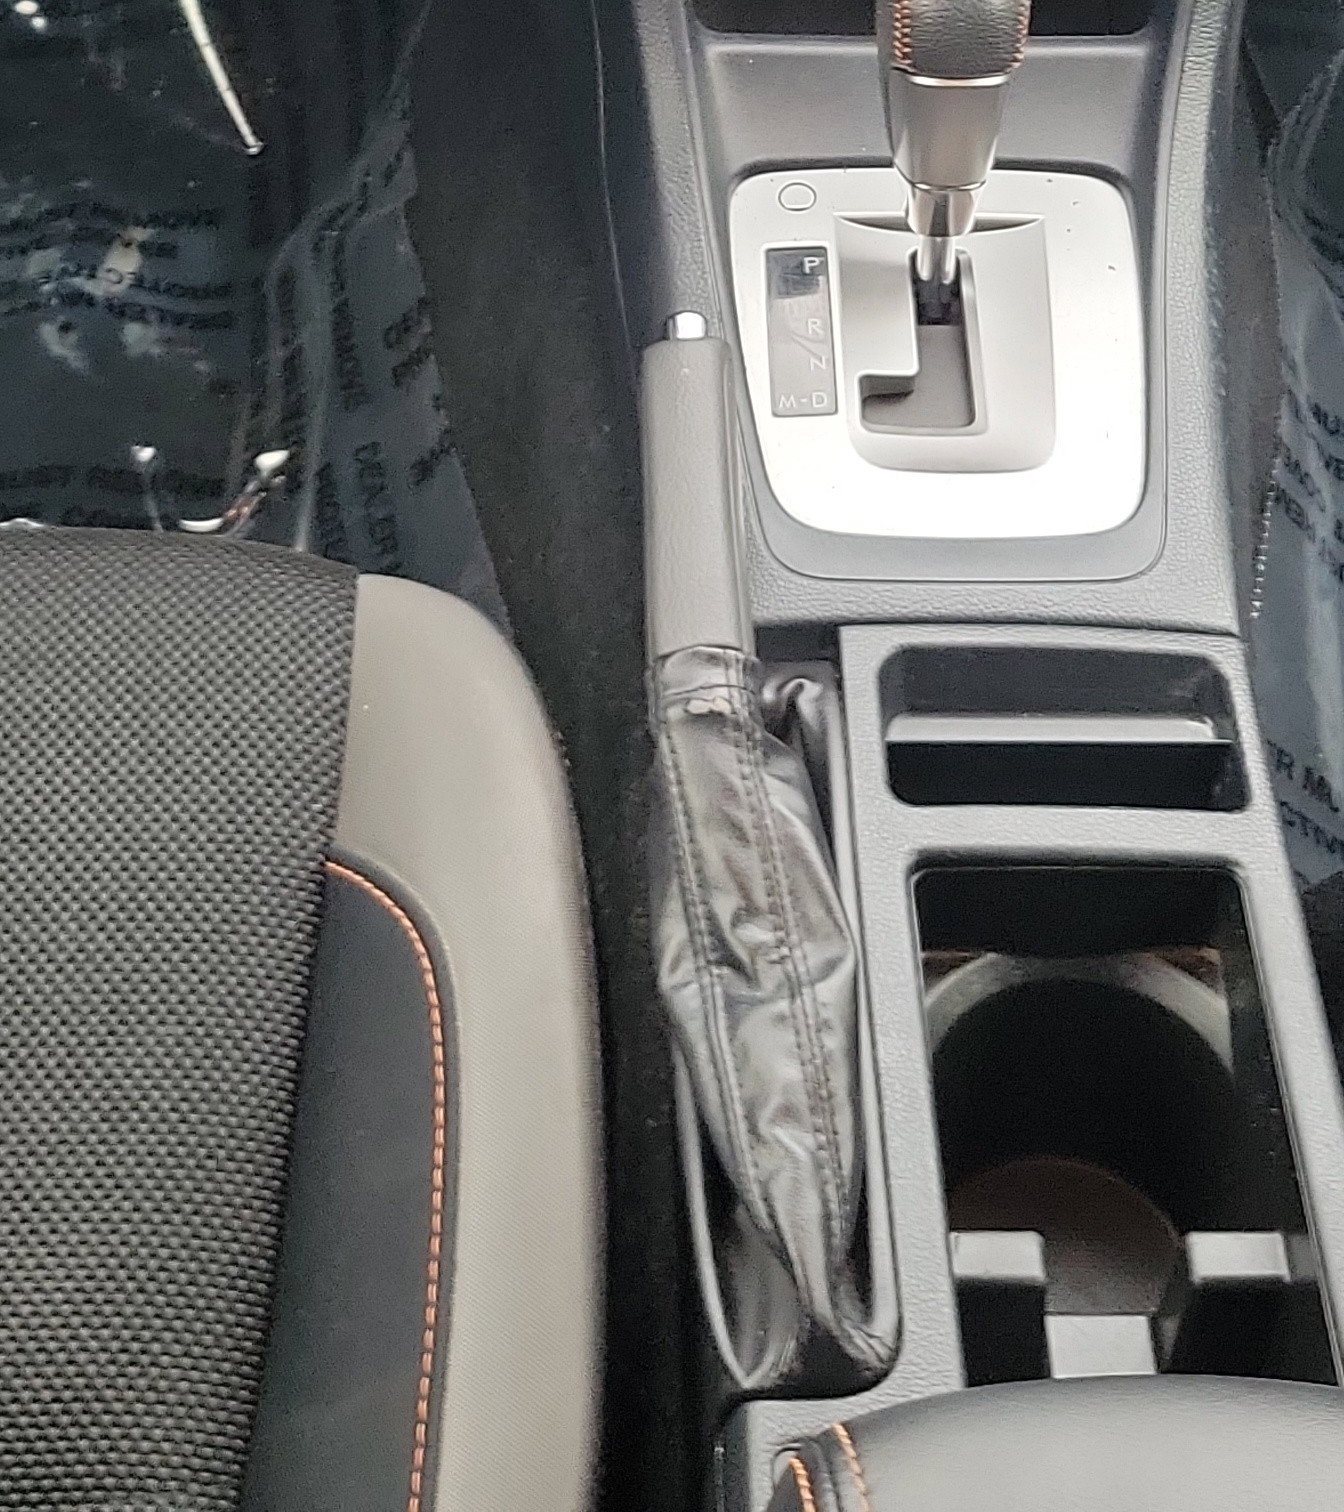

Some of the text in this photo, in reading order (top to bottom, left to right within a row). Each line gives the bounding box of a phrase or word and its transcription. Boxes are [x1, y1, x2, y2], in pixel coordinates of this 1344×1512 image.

[803, 256, 821, 274] P
[808, 317, 825, 335] R
[810, 355, 827, 372] N
